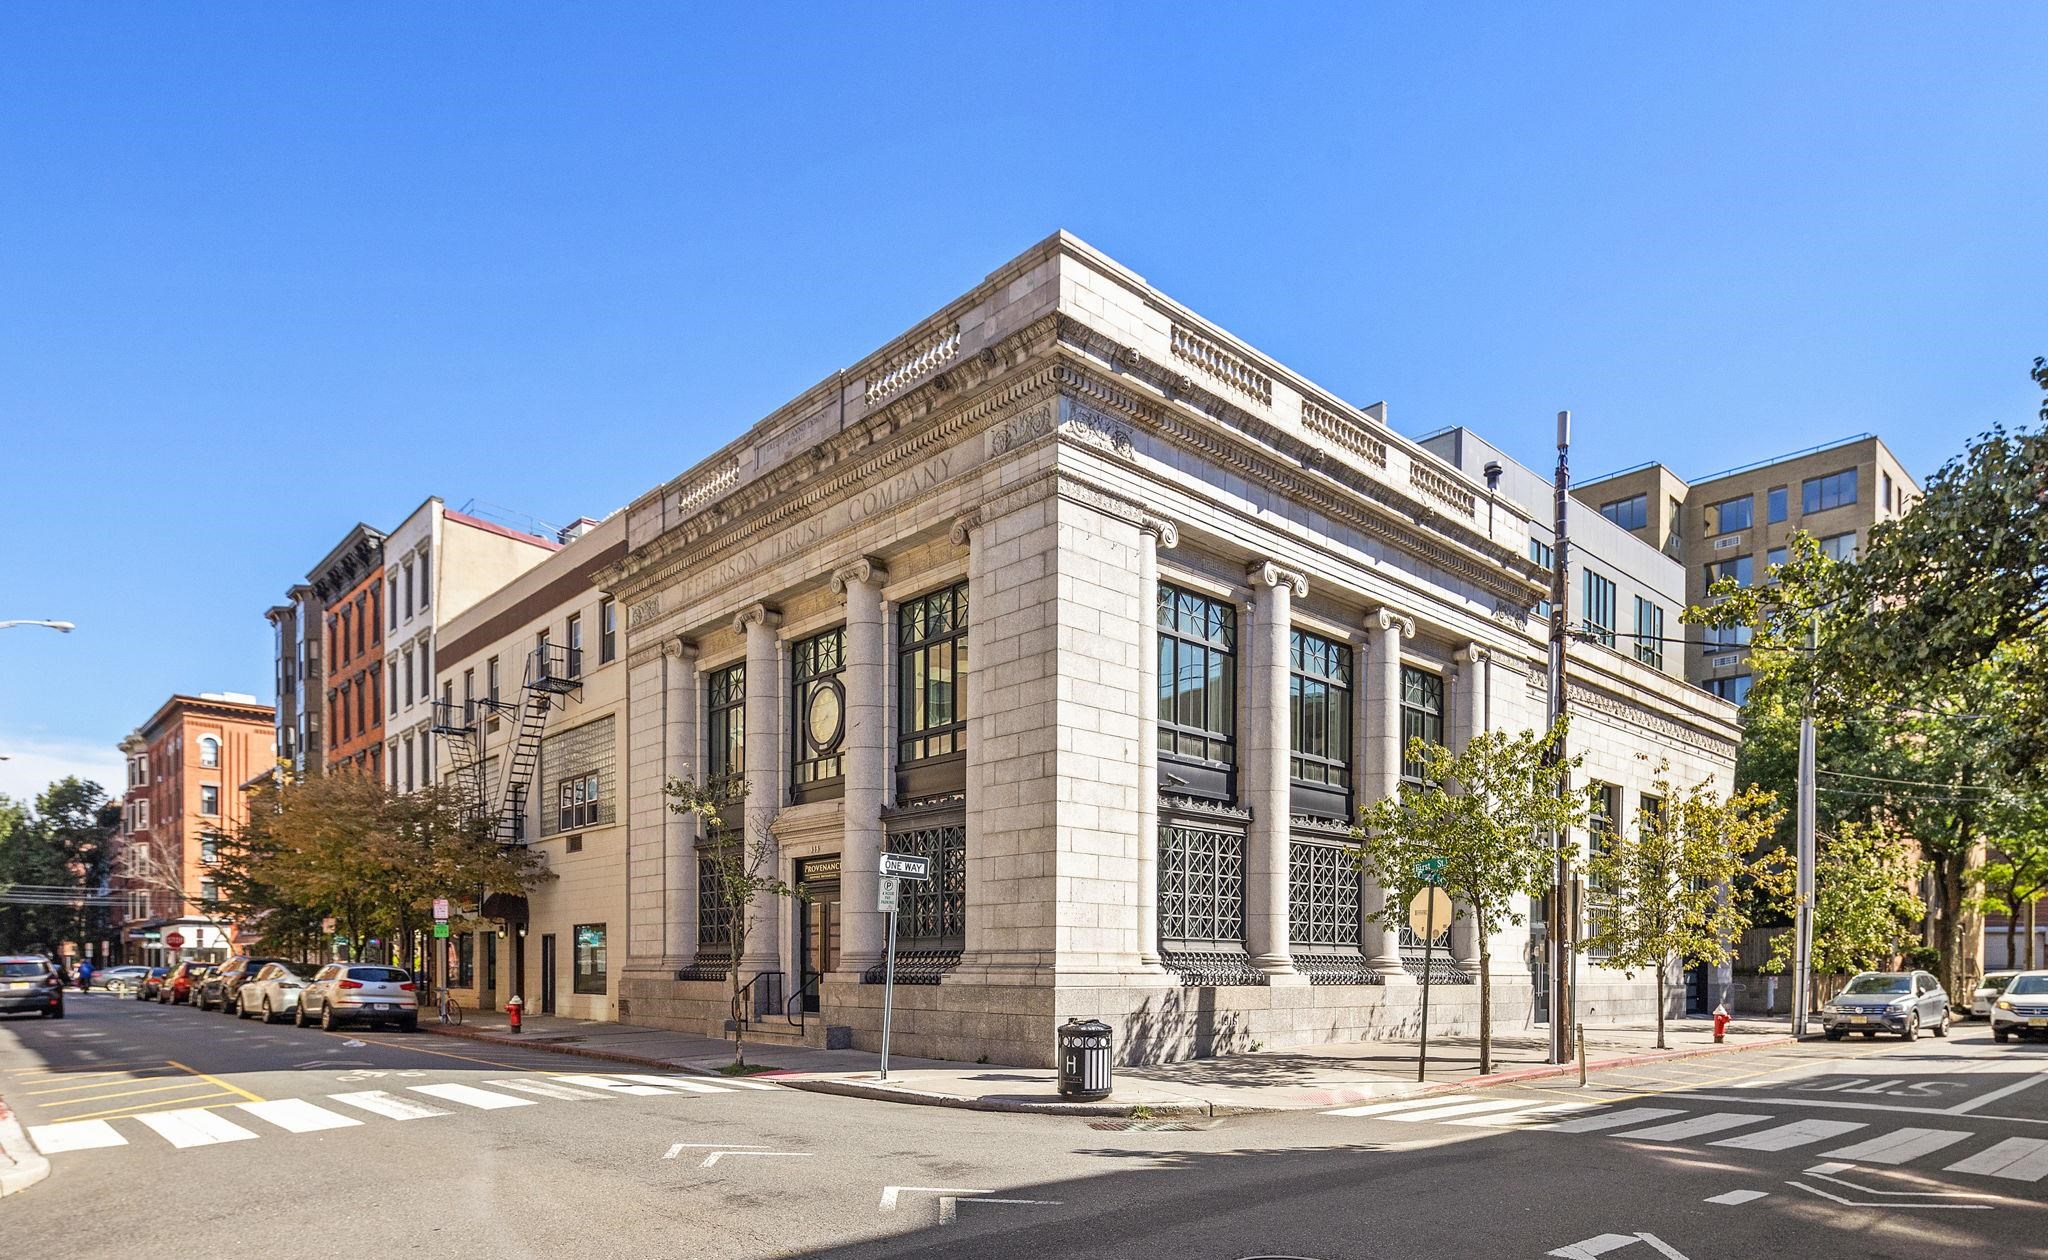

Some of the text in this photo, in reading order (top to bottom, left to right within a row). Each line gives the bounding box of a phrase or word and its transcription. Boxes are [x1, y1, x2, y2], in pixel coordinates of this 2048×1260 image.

[680, 453, 953, 602] JEFFERSON TRUST COMPANY
[804, 862, 841, 873] PROVENANC
[885, 860, 923, 873] ONE WAY
[1416, 859, 1444, 872] First St
[1066, 1055, 1077, 1075] H
